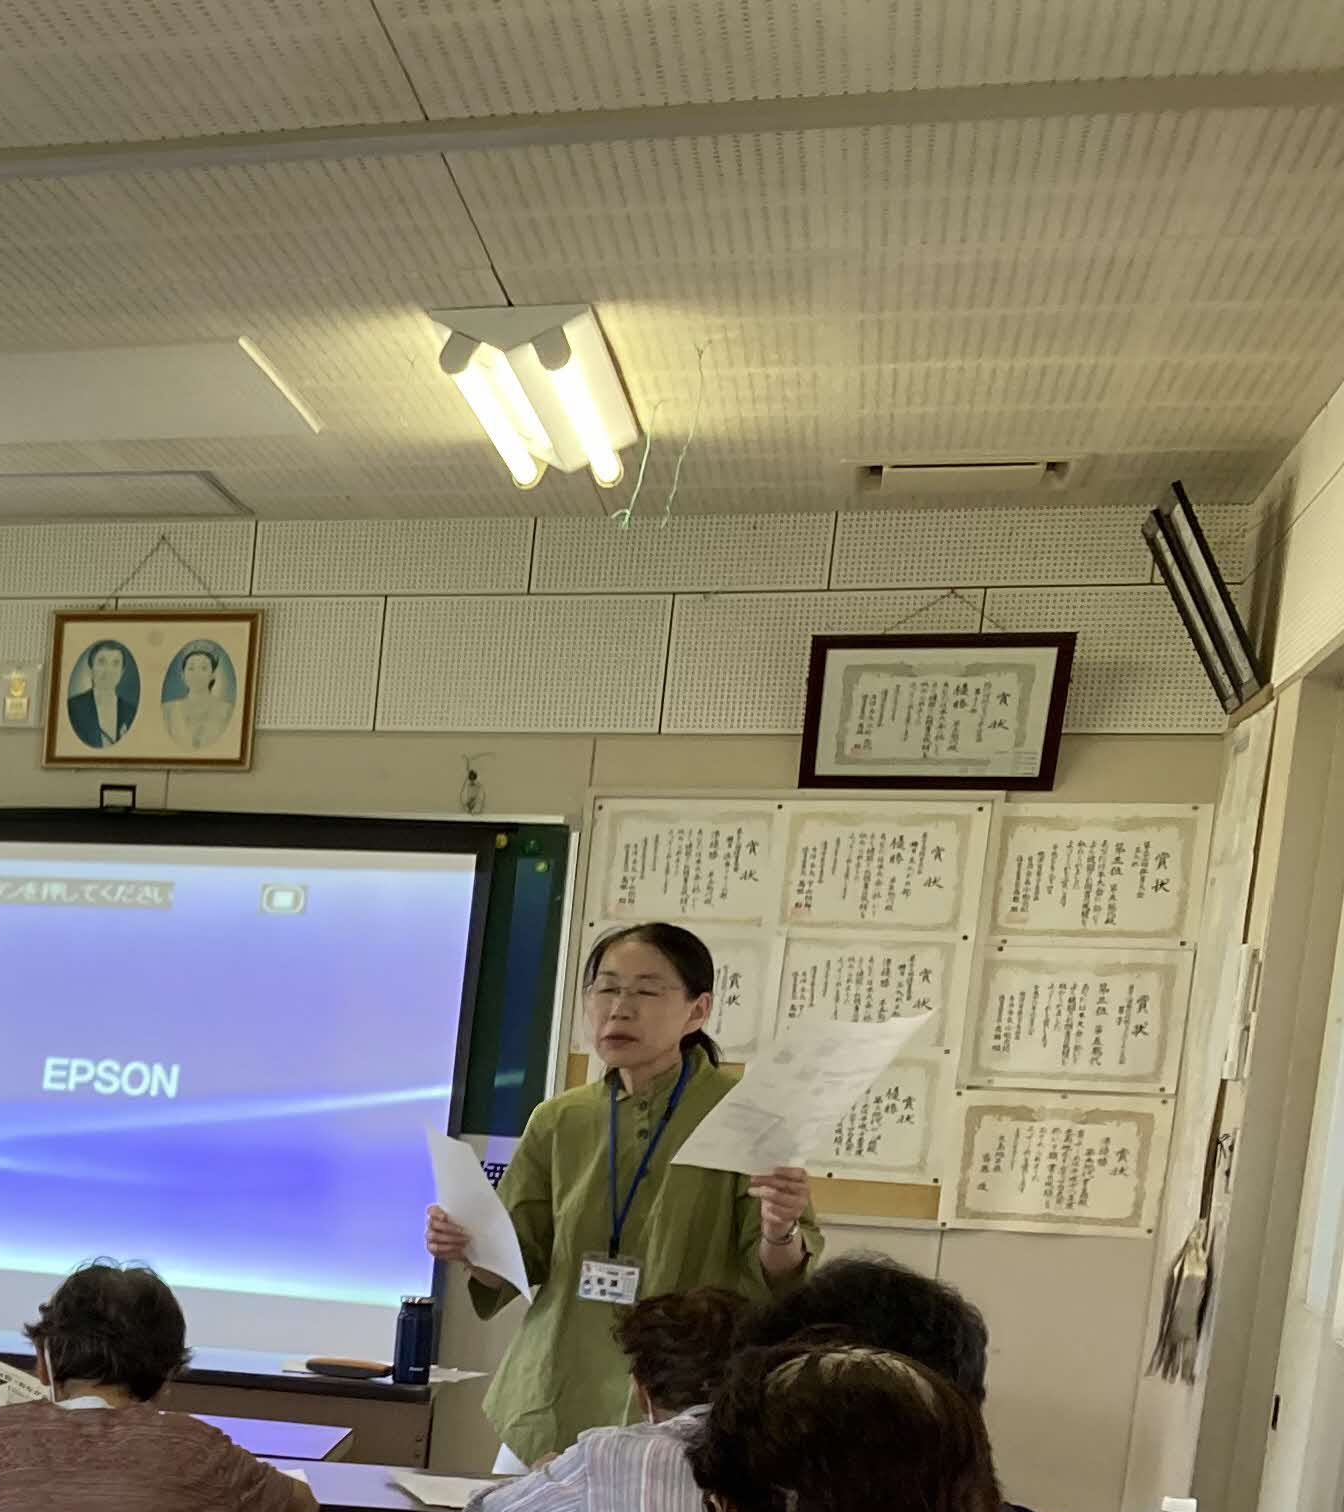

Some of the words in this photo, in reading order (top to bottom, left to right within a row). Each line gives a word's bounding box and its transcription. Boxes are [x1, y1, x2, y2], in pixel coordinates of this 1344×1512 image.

[1150, 851, 1171, 893] 賞状
[1130, 994, 1150, 1037] 賞状
[42, 1057, 180, 1099] EPSON
